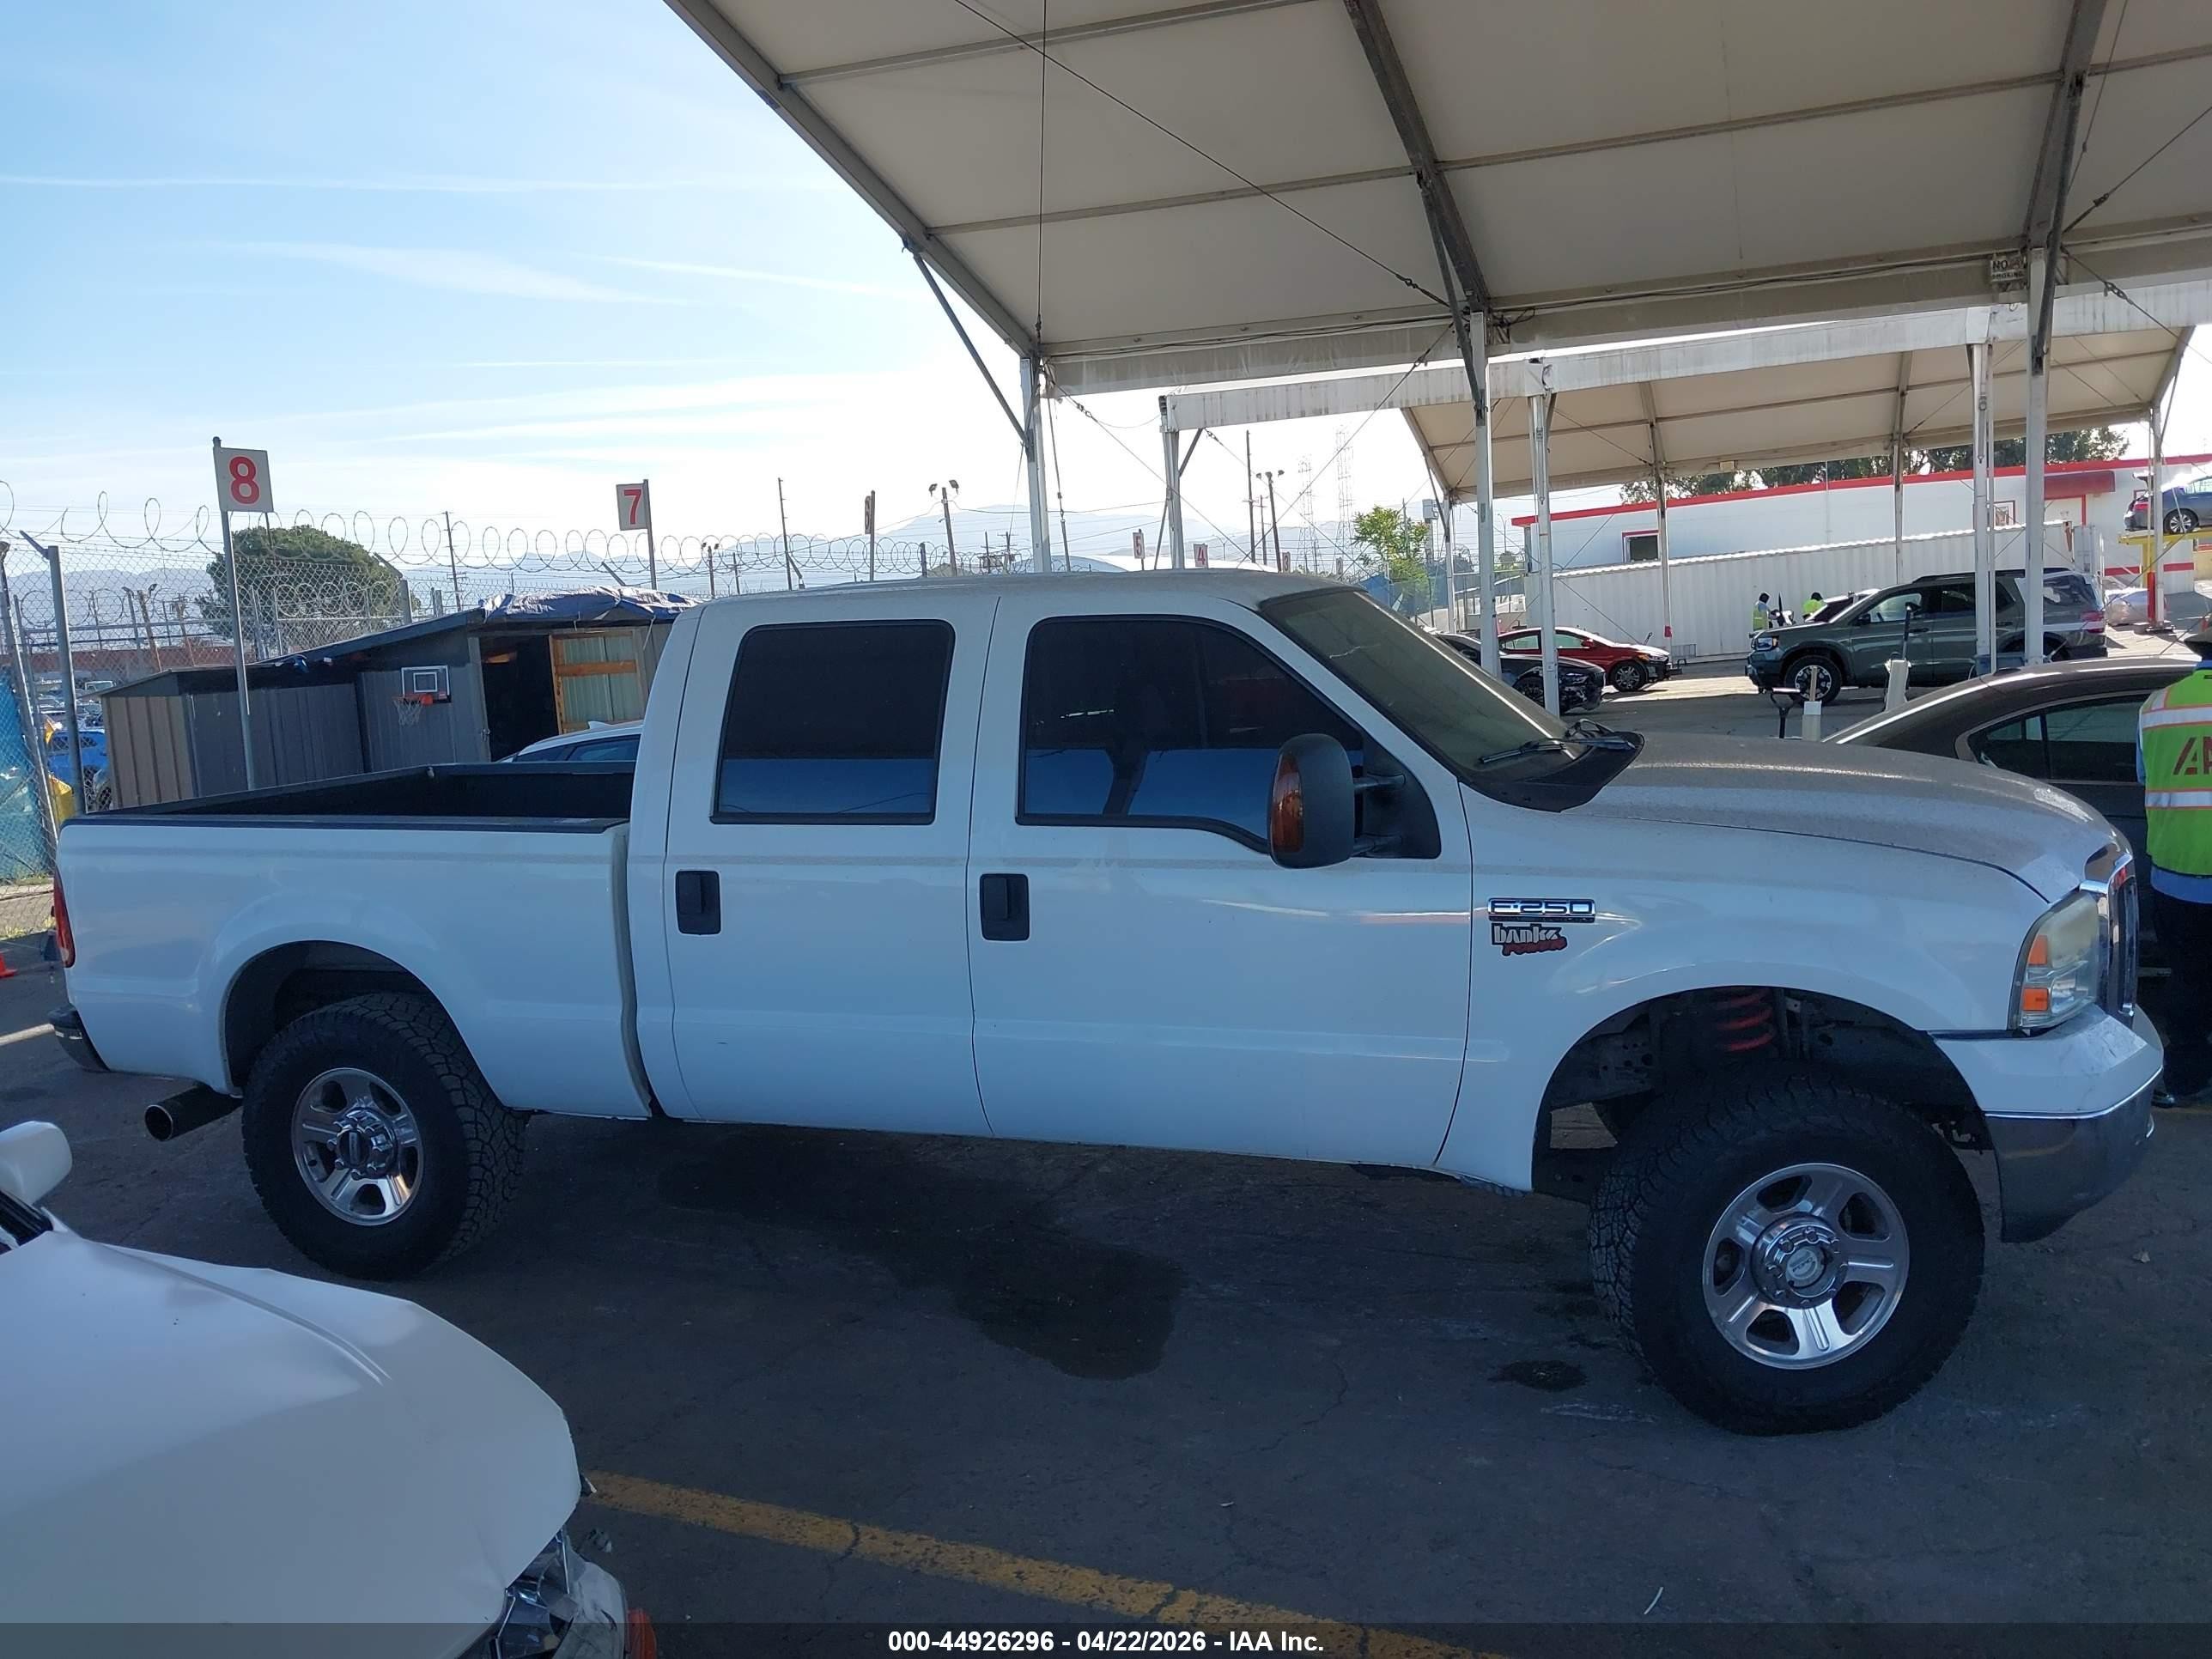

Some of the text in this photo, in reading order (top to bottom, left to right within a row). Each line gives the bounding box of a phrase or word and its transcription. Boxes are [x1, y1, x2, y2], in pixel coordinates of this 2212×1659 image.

[1992, 260, 2008, 270] NO
[229, 456, 260, 505] 8
[623, 489, 642, 525] 7
[1135, 535, 1142, 556] 5
[1197, 547, 1206, 565] 4
